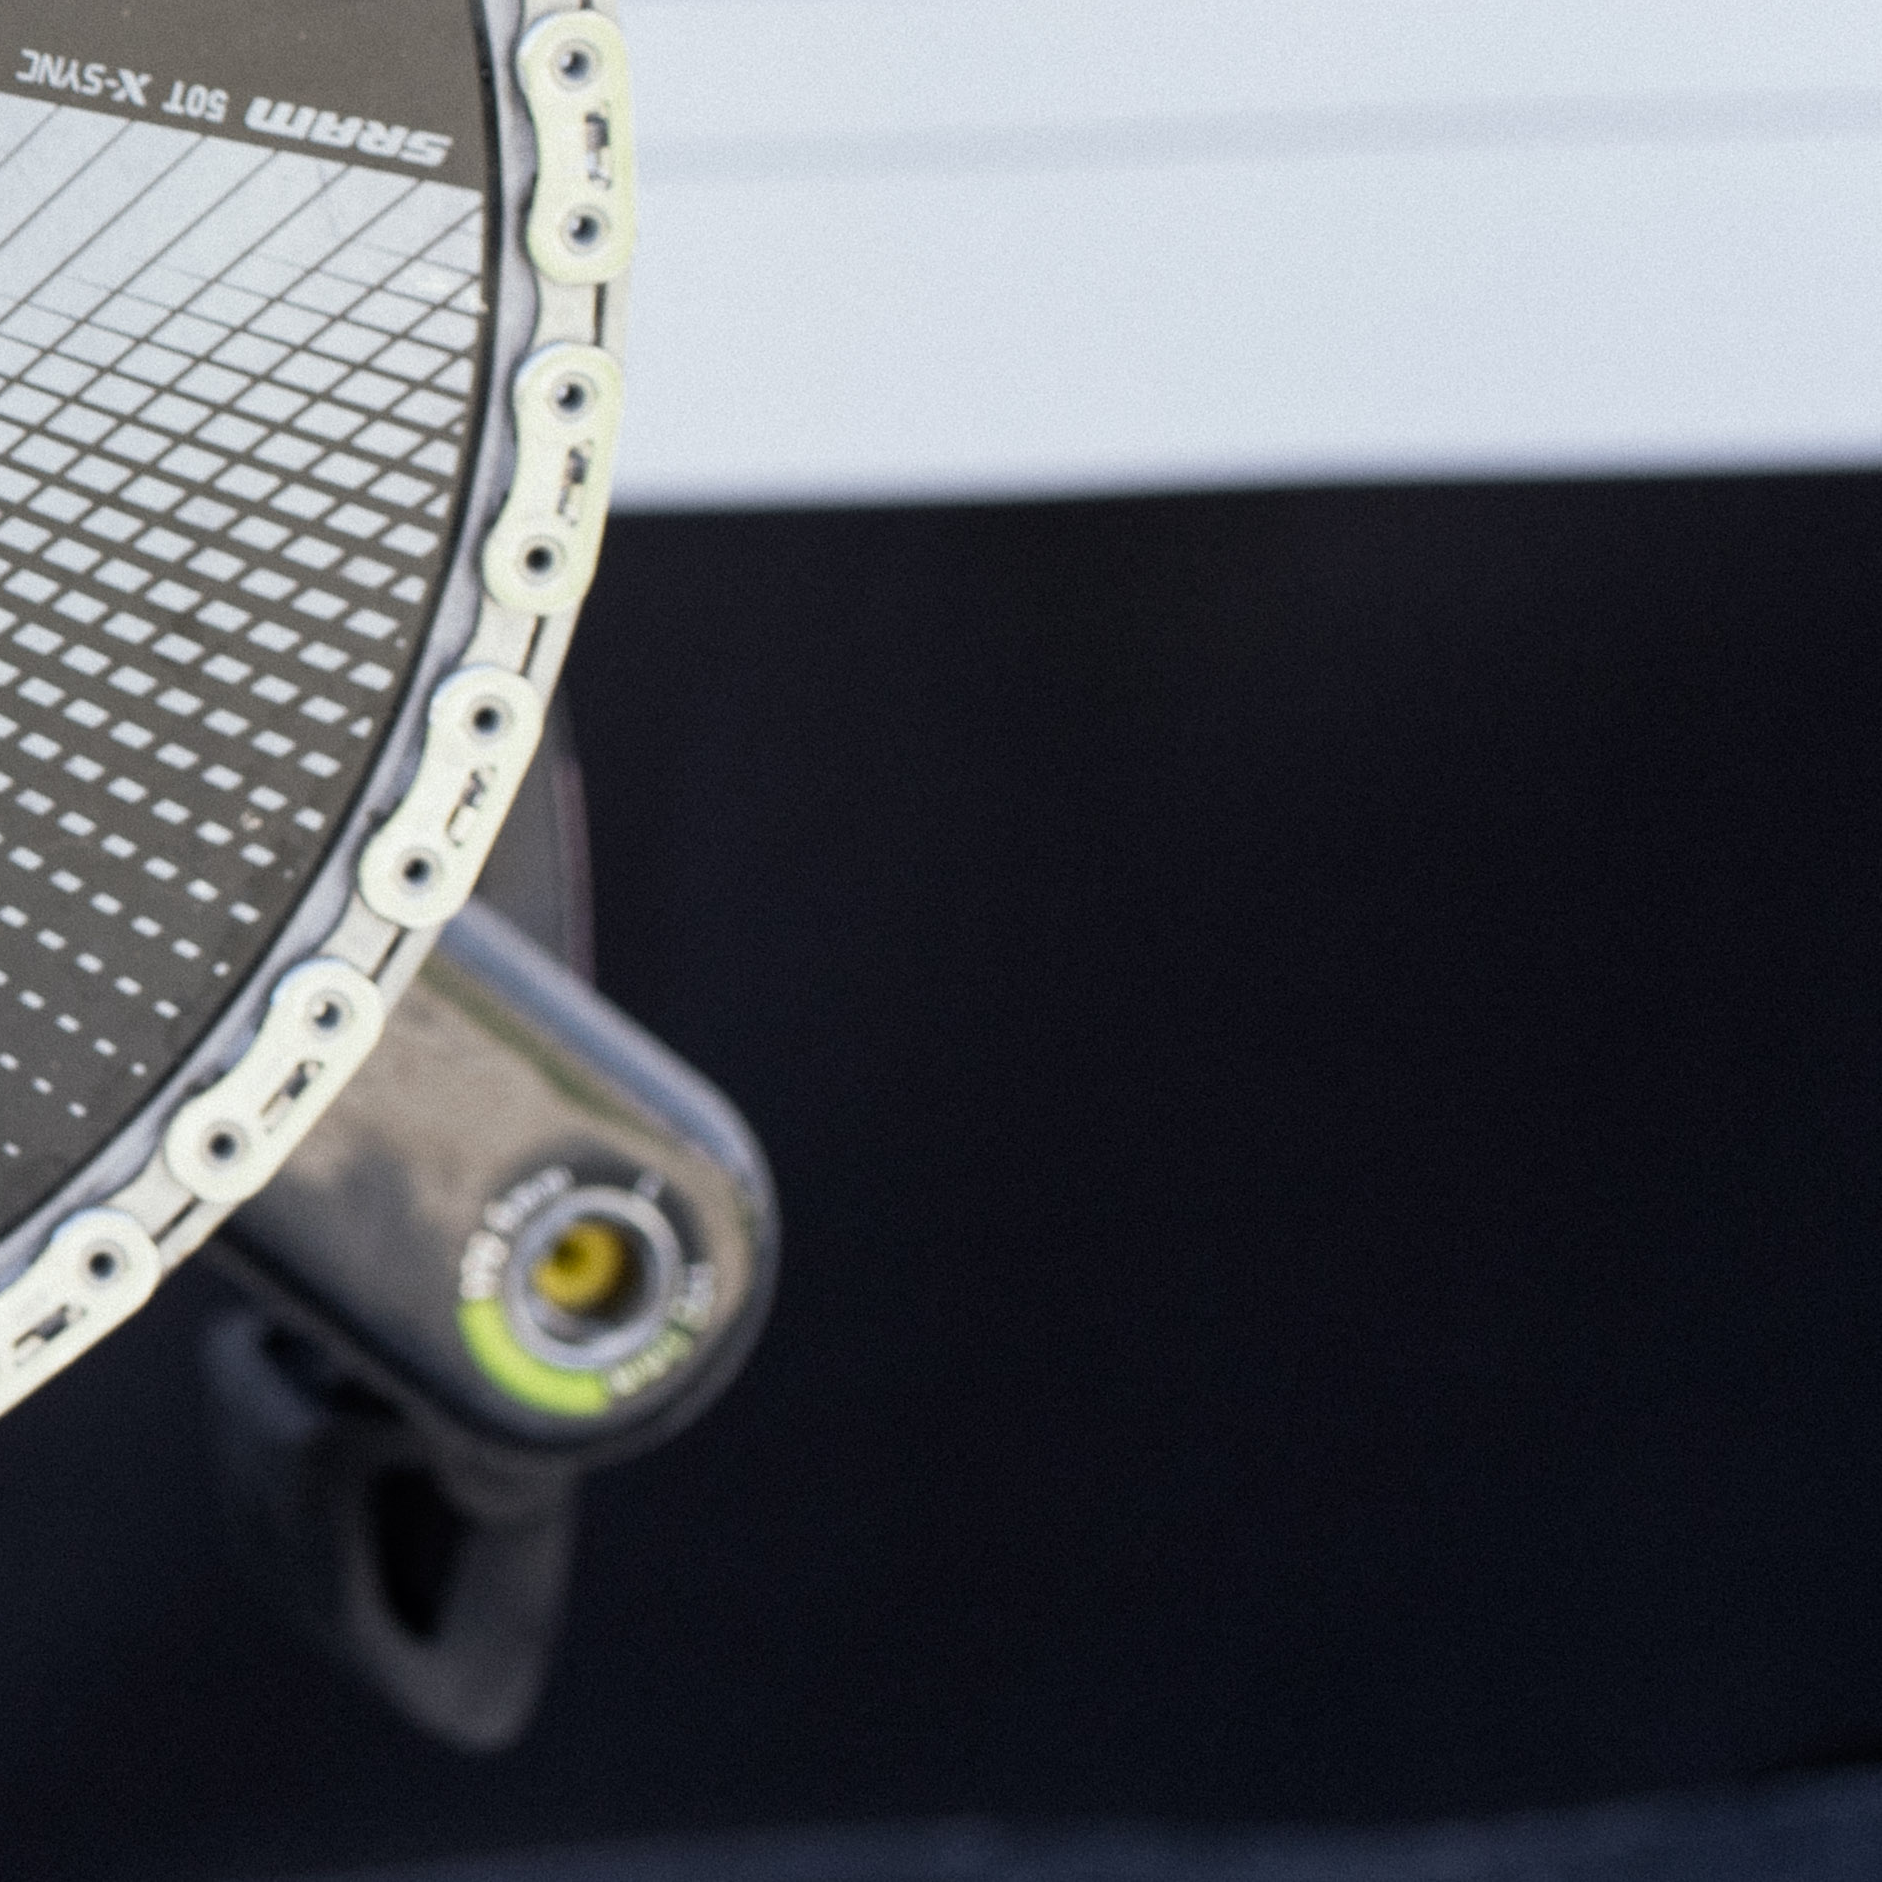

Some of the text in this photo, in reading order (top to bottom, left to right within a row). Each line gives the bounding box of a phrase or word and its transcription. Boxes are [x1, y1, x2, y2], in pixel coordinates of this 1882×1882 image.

[16, 49, 454, 167] SRAM 50T X-SYNC
